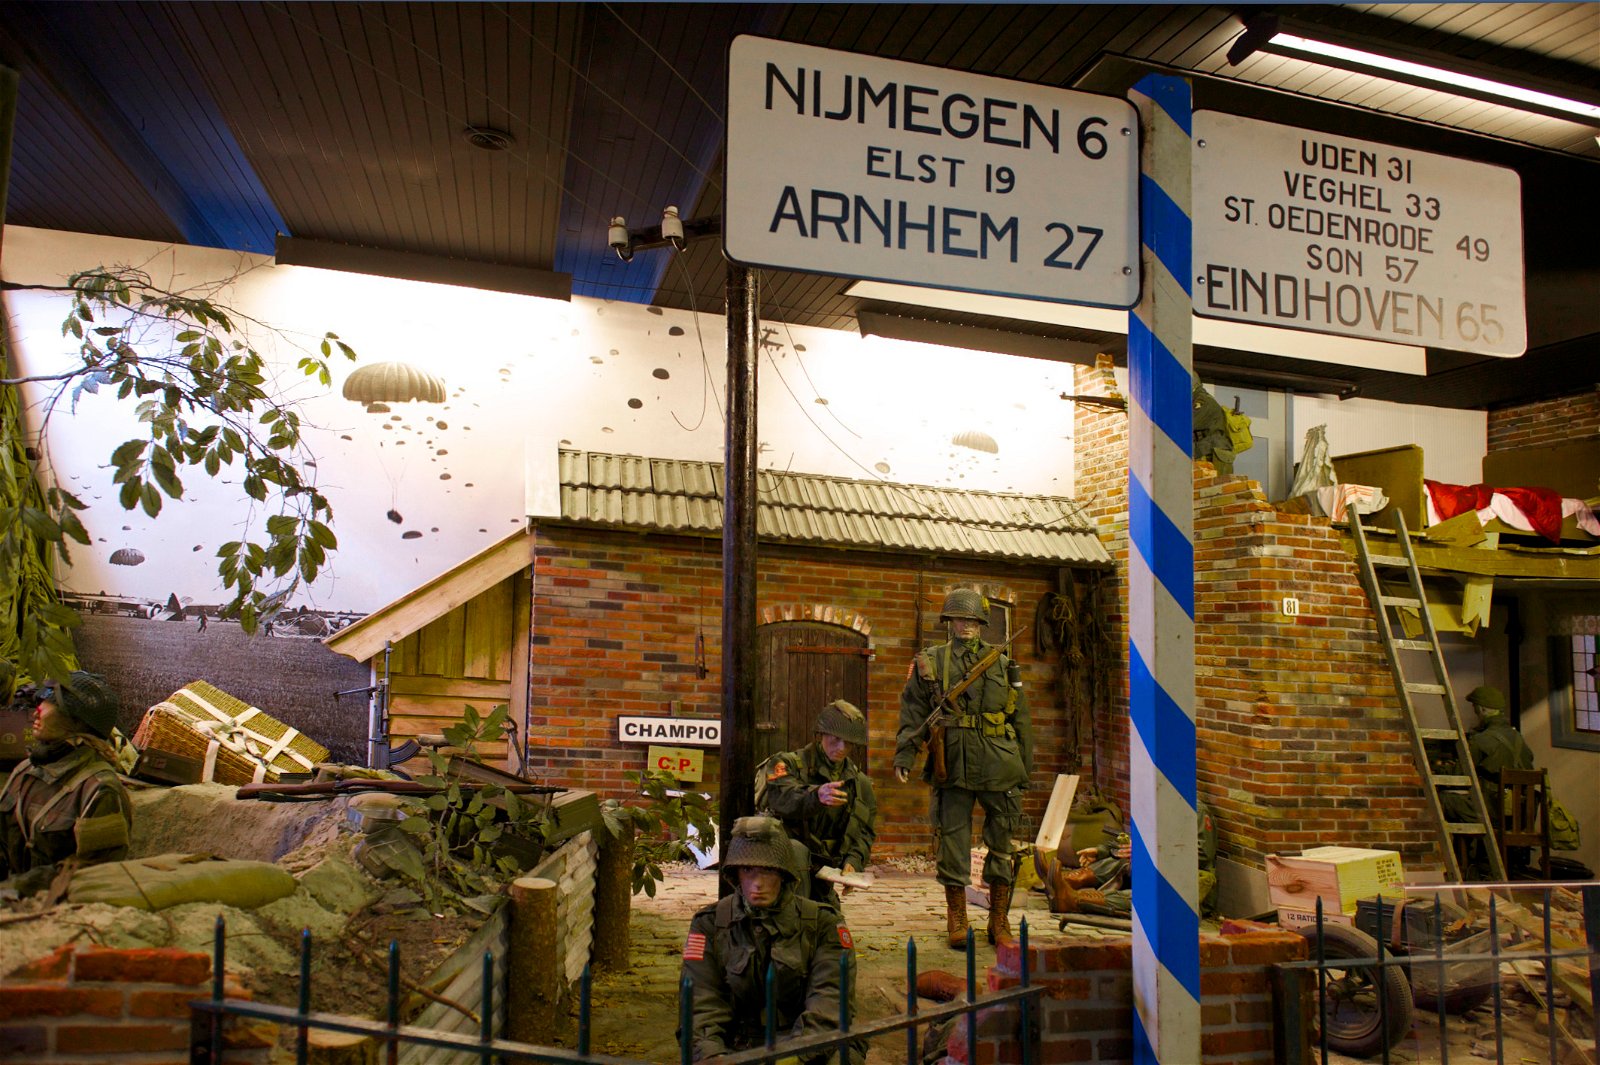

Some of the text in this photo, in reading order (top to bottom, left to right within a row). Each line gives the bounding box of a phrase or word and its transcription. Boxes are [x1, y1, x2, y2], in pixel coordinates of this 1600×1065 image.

[764, 61, 1109, 161] NIJMEGEN 6
[866, 145, 1016, 195] ELST 19
[1300, 139, 1413, 185] UDEN 31
[1283, 169, 1441, 222] VEGHEL 33
[768, 184, 1106, 272] ARNHEM 27
[1223, 195, 1491, 263] ST. OEDENRODE 49
[1306, 243, 1419, 285] SON 57
[1206, 263, 1504, 345] EINDHOVEN 65
[1286, 600, 1296, 614] 81
[624, 722, 719, 740] CHAMPIO
[657, 756, 696, 772] C.P.
